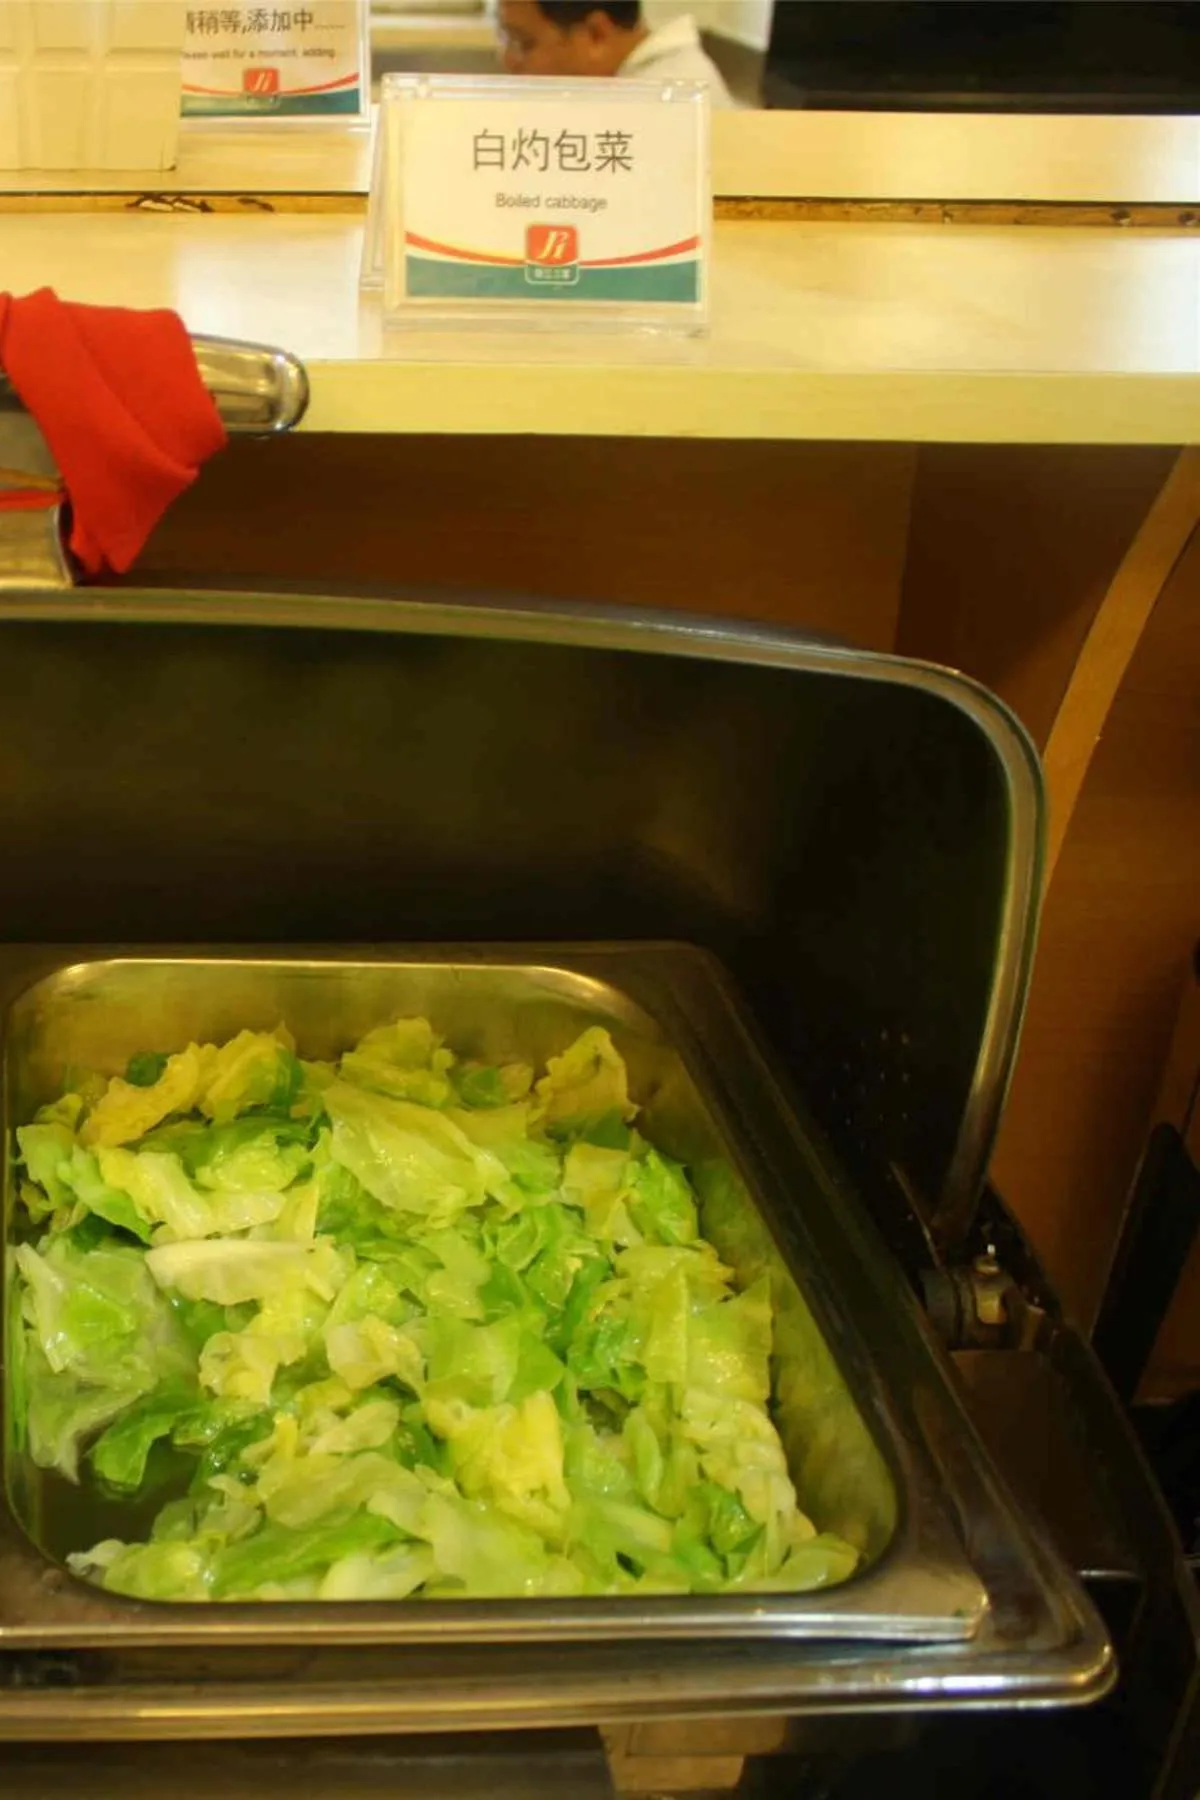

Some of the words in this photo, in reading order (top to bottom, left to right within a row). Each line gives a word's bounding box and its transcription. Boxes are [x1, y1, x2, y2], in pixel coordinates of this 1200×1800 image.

[472, 128, 635, 174] 白灼包菜
[495, 193, 541, 209] Boiled
[545, 194, 609, 213] cabbage
